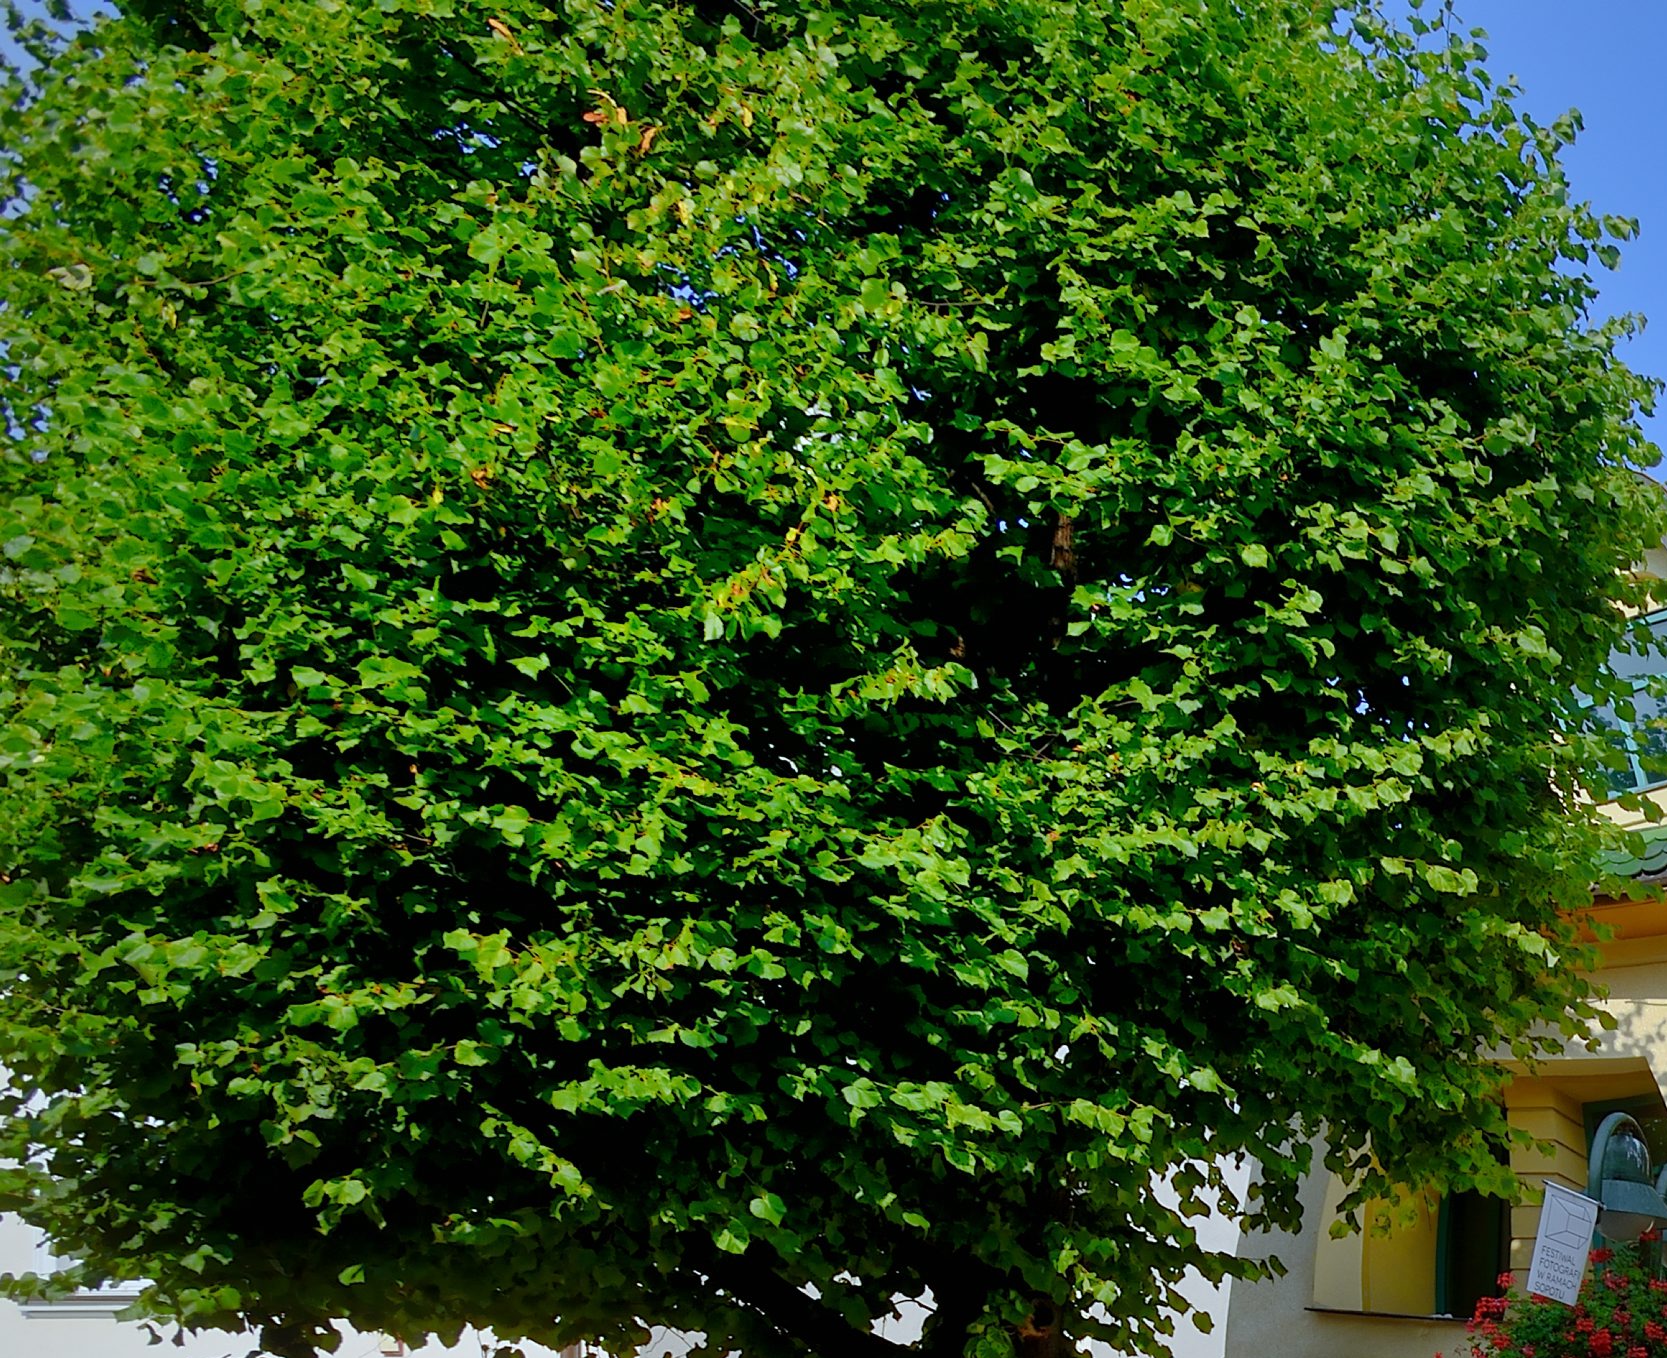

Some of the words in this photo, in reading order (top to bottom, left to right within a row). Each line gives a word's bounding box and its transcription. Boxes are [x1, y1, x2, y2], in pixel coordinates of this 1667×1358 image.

[1541, 1245, 1576, 1266] FESTIWAL
[1534, 1281, 1566, 1299] SOPOTU
[1537, 1270, 1544, 1279] W
[1546, 1273, 1577, 1290] RAMACH
